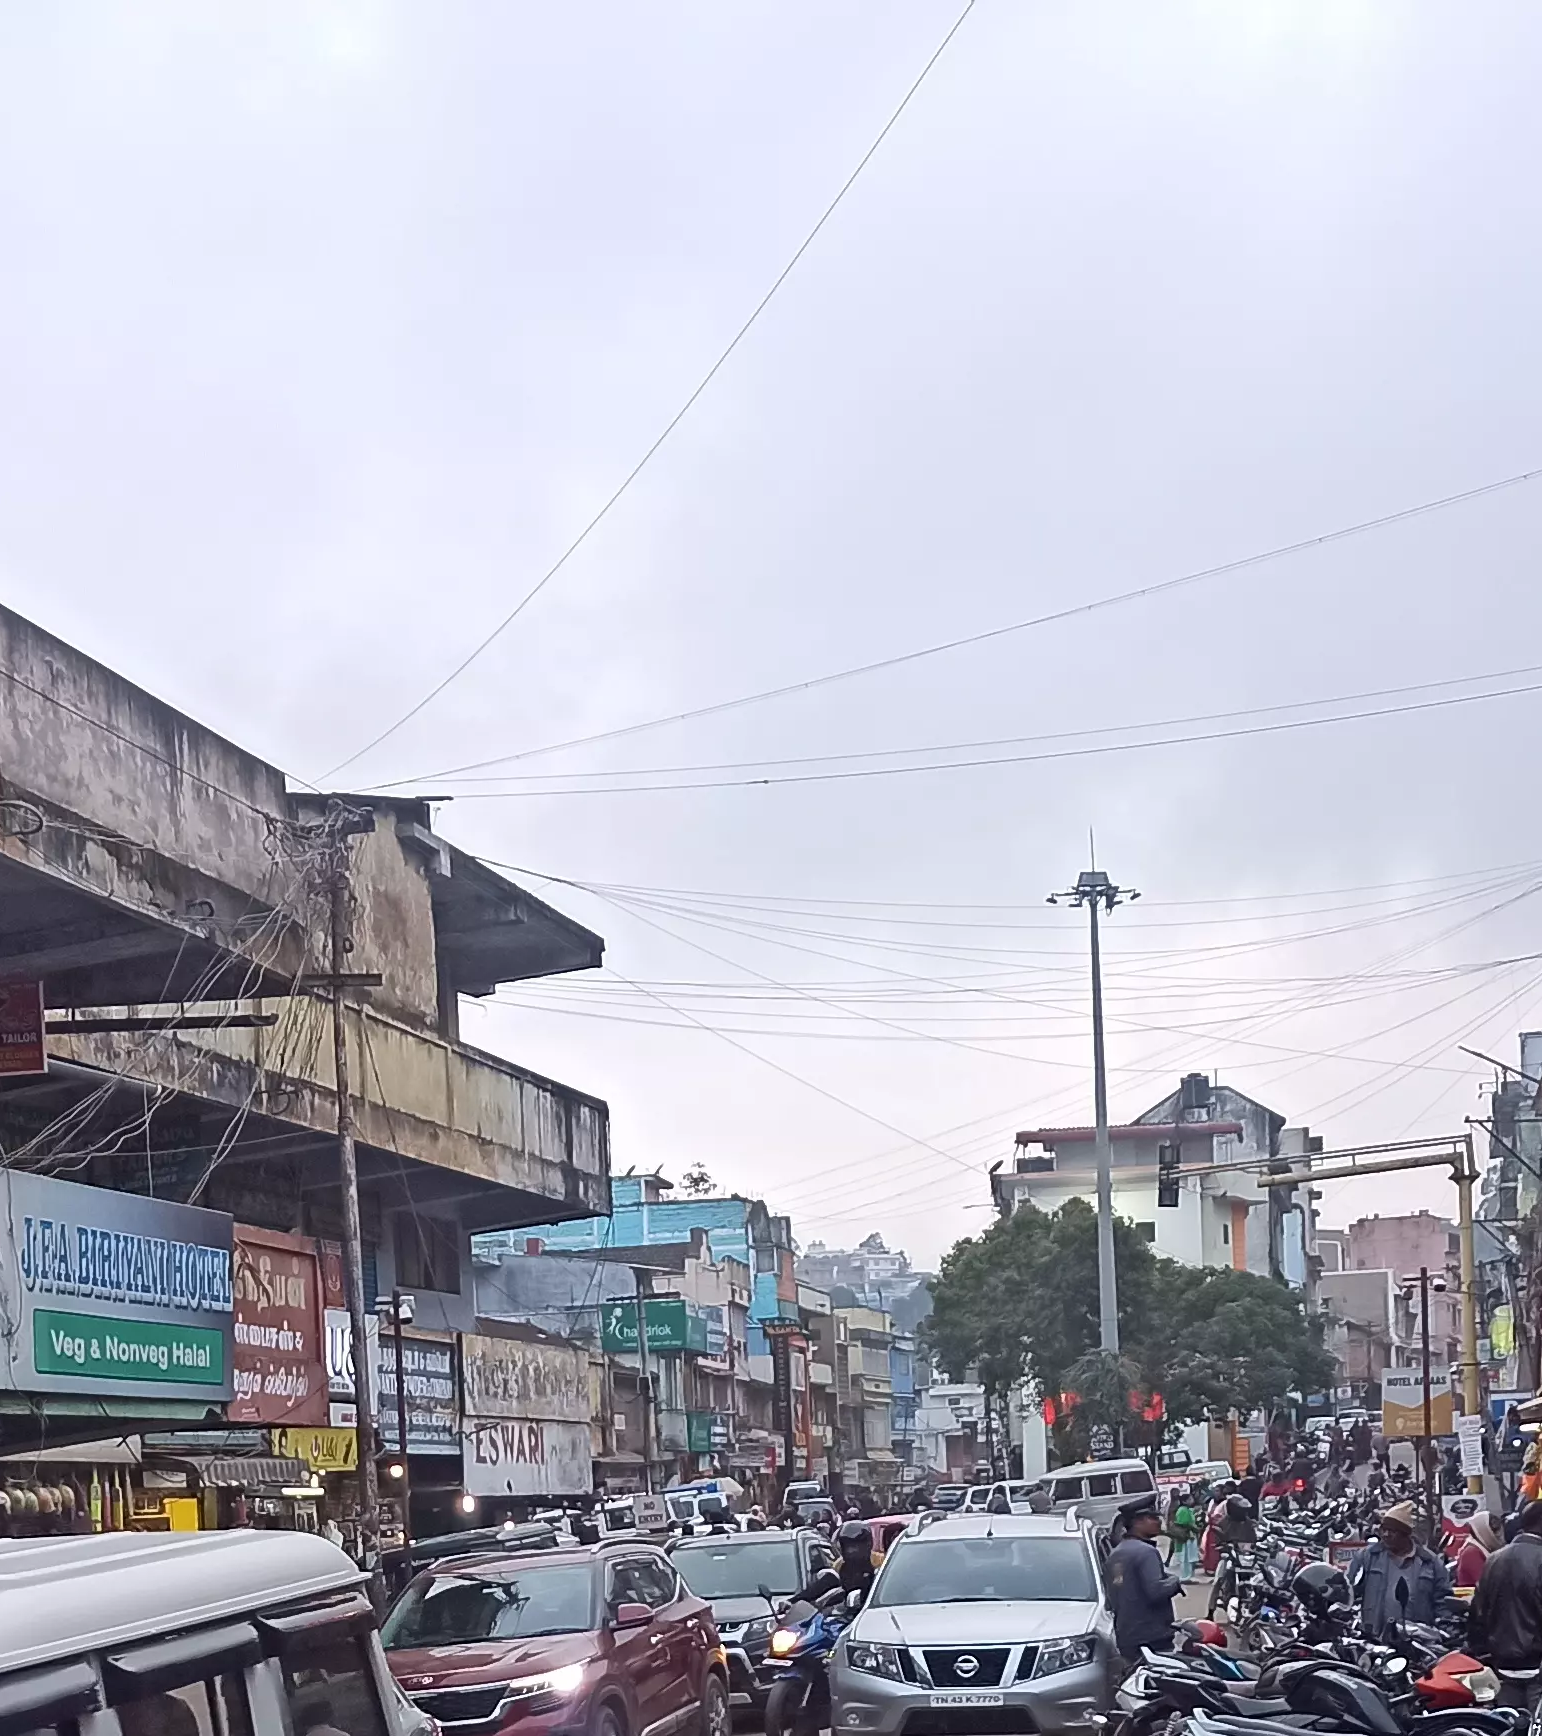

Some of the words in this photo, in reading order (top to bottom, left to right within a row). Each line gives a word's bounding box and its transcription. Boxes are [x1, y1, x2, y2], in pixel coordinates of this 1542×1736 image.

[3, 1032, 37, 1043] TAILOR
[172, 1242, 232, 1312] HOTEL
[50, 1330, 85, 1360] Veg
[90, 1341, 100, 1358] &
[105, 1335, 168, 1370] Nonveg
[172, 1341, 210, 1369] Halal
[1387, 1376, 1410, 1387] HOTEL
[473, 1419, 545, 1466] ESWARI
[950, 1696, 963, 1705] 43
